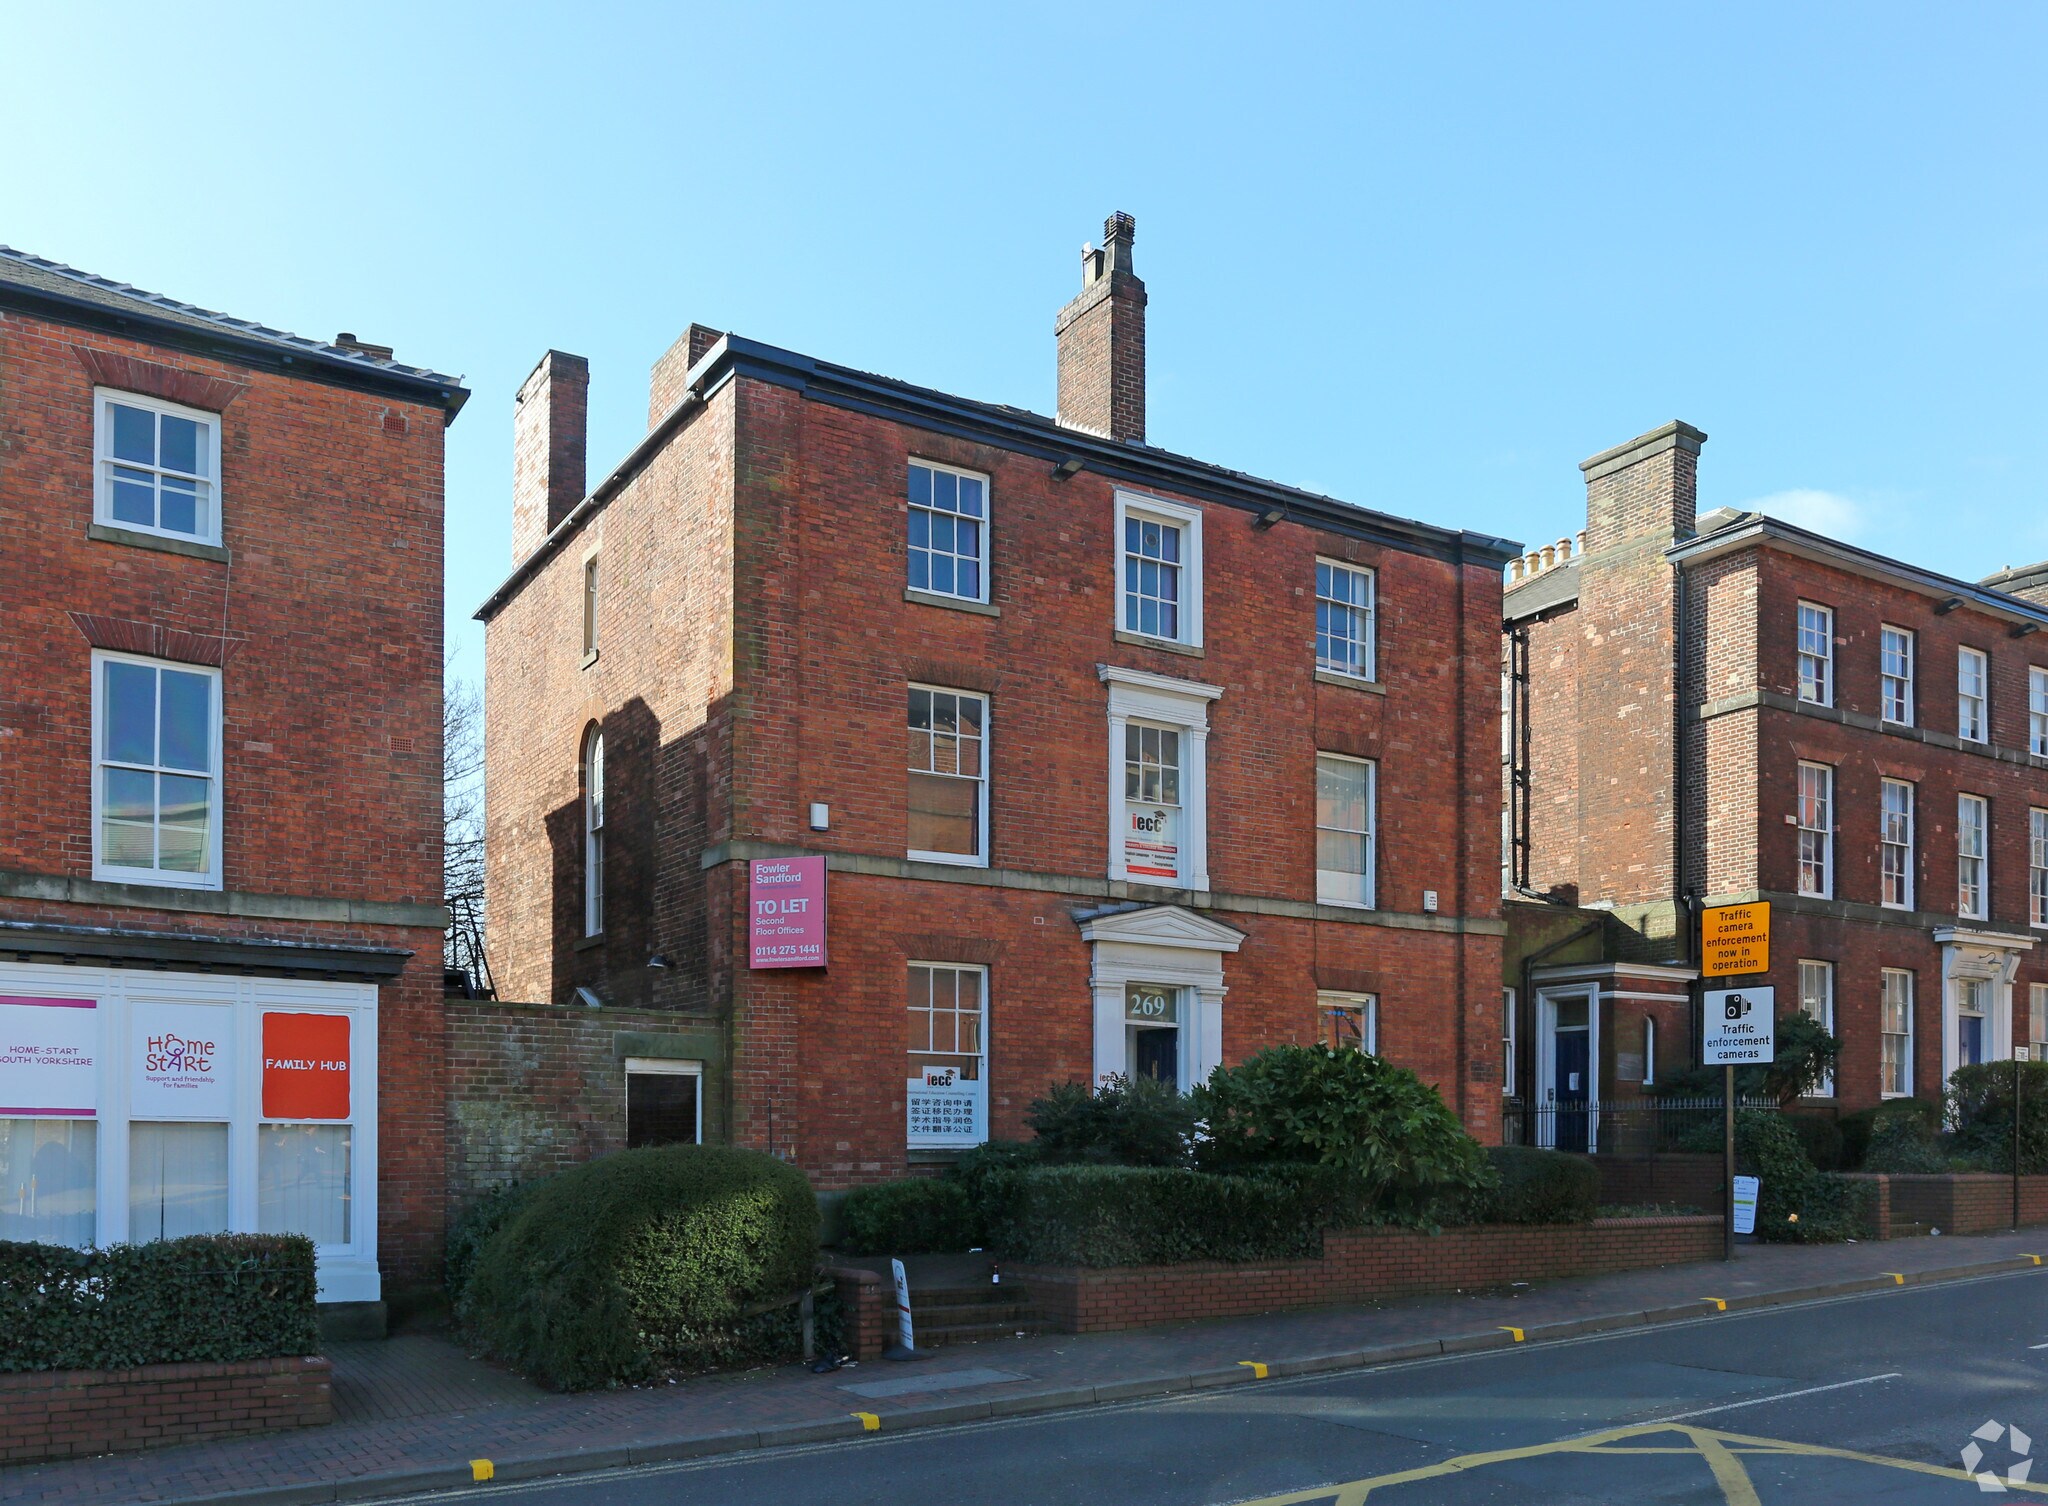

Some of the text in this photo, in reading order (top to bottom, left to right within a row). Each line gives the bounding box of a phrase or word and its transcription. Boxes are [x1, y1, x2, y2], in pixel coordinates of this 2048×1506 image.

[1132, 813, 1162, 832] iecc
[756, 864, 790, 874] Fowler
[756, 872, 801, 884] Sandford
[756, 898, 809, 914] TO LET
[756, 917, 784, 925] Second
[1719, 910, 1752, 921] Traffic
[1718, 922, 1753, 932] camera
[1706, 933, 1766, 947] enforcement
[756, 944, 820, 955] 0114 275 1441
[1718, 947, 1750, 958] now in
[1712, 958, 1758, 972] operation
[1131, 994, 1165, 1016] 269
[1722, 1023, 1754, 1034] Traffic
[1707, 1035, 1770, 1047] enforcement
[9, 1046, 79, 1055] HOME-START
[1717, 1048, 1759, 1059] cameras
[36, 1057, 93, 1066] YORKSHIRE
[266, 1059, 346, 1071] FAMILY HUB
[927, 1073, 952, 1086] iecc
[911, 1098, 972, 1107] 留学咨询申请
